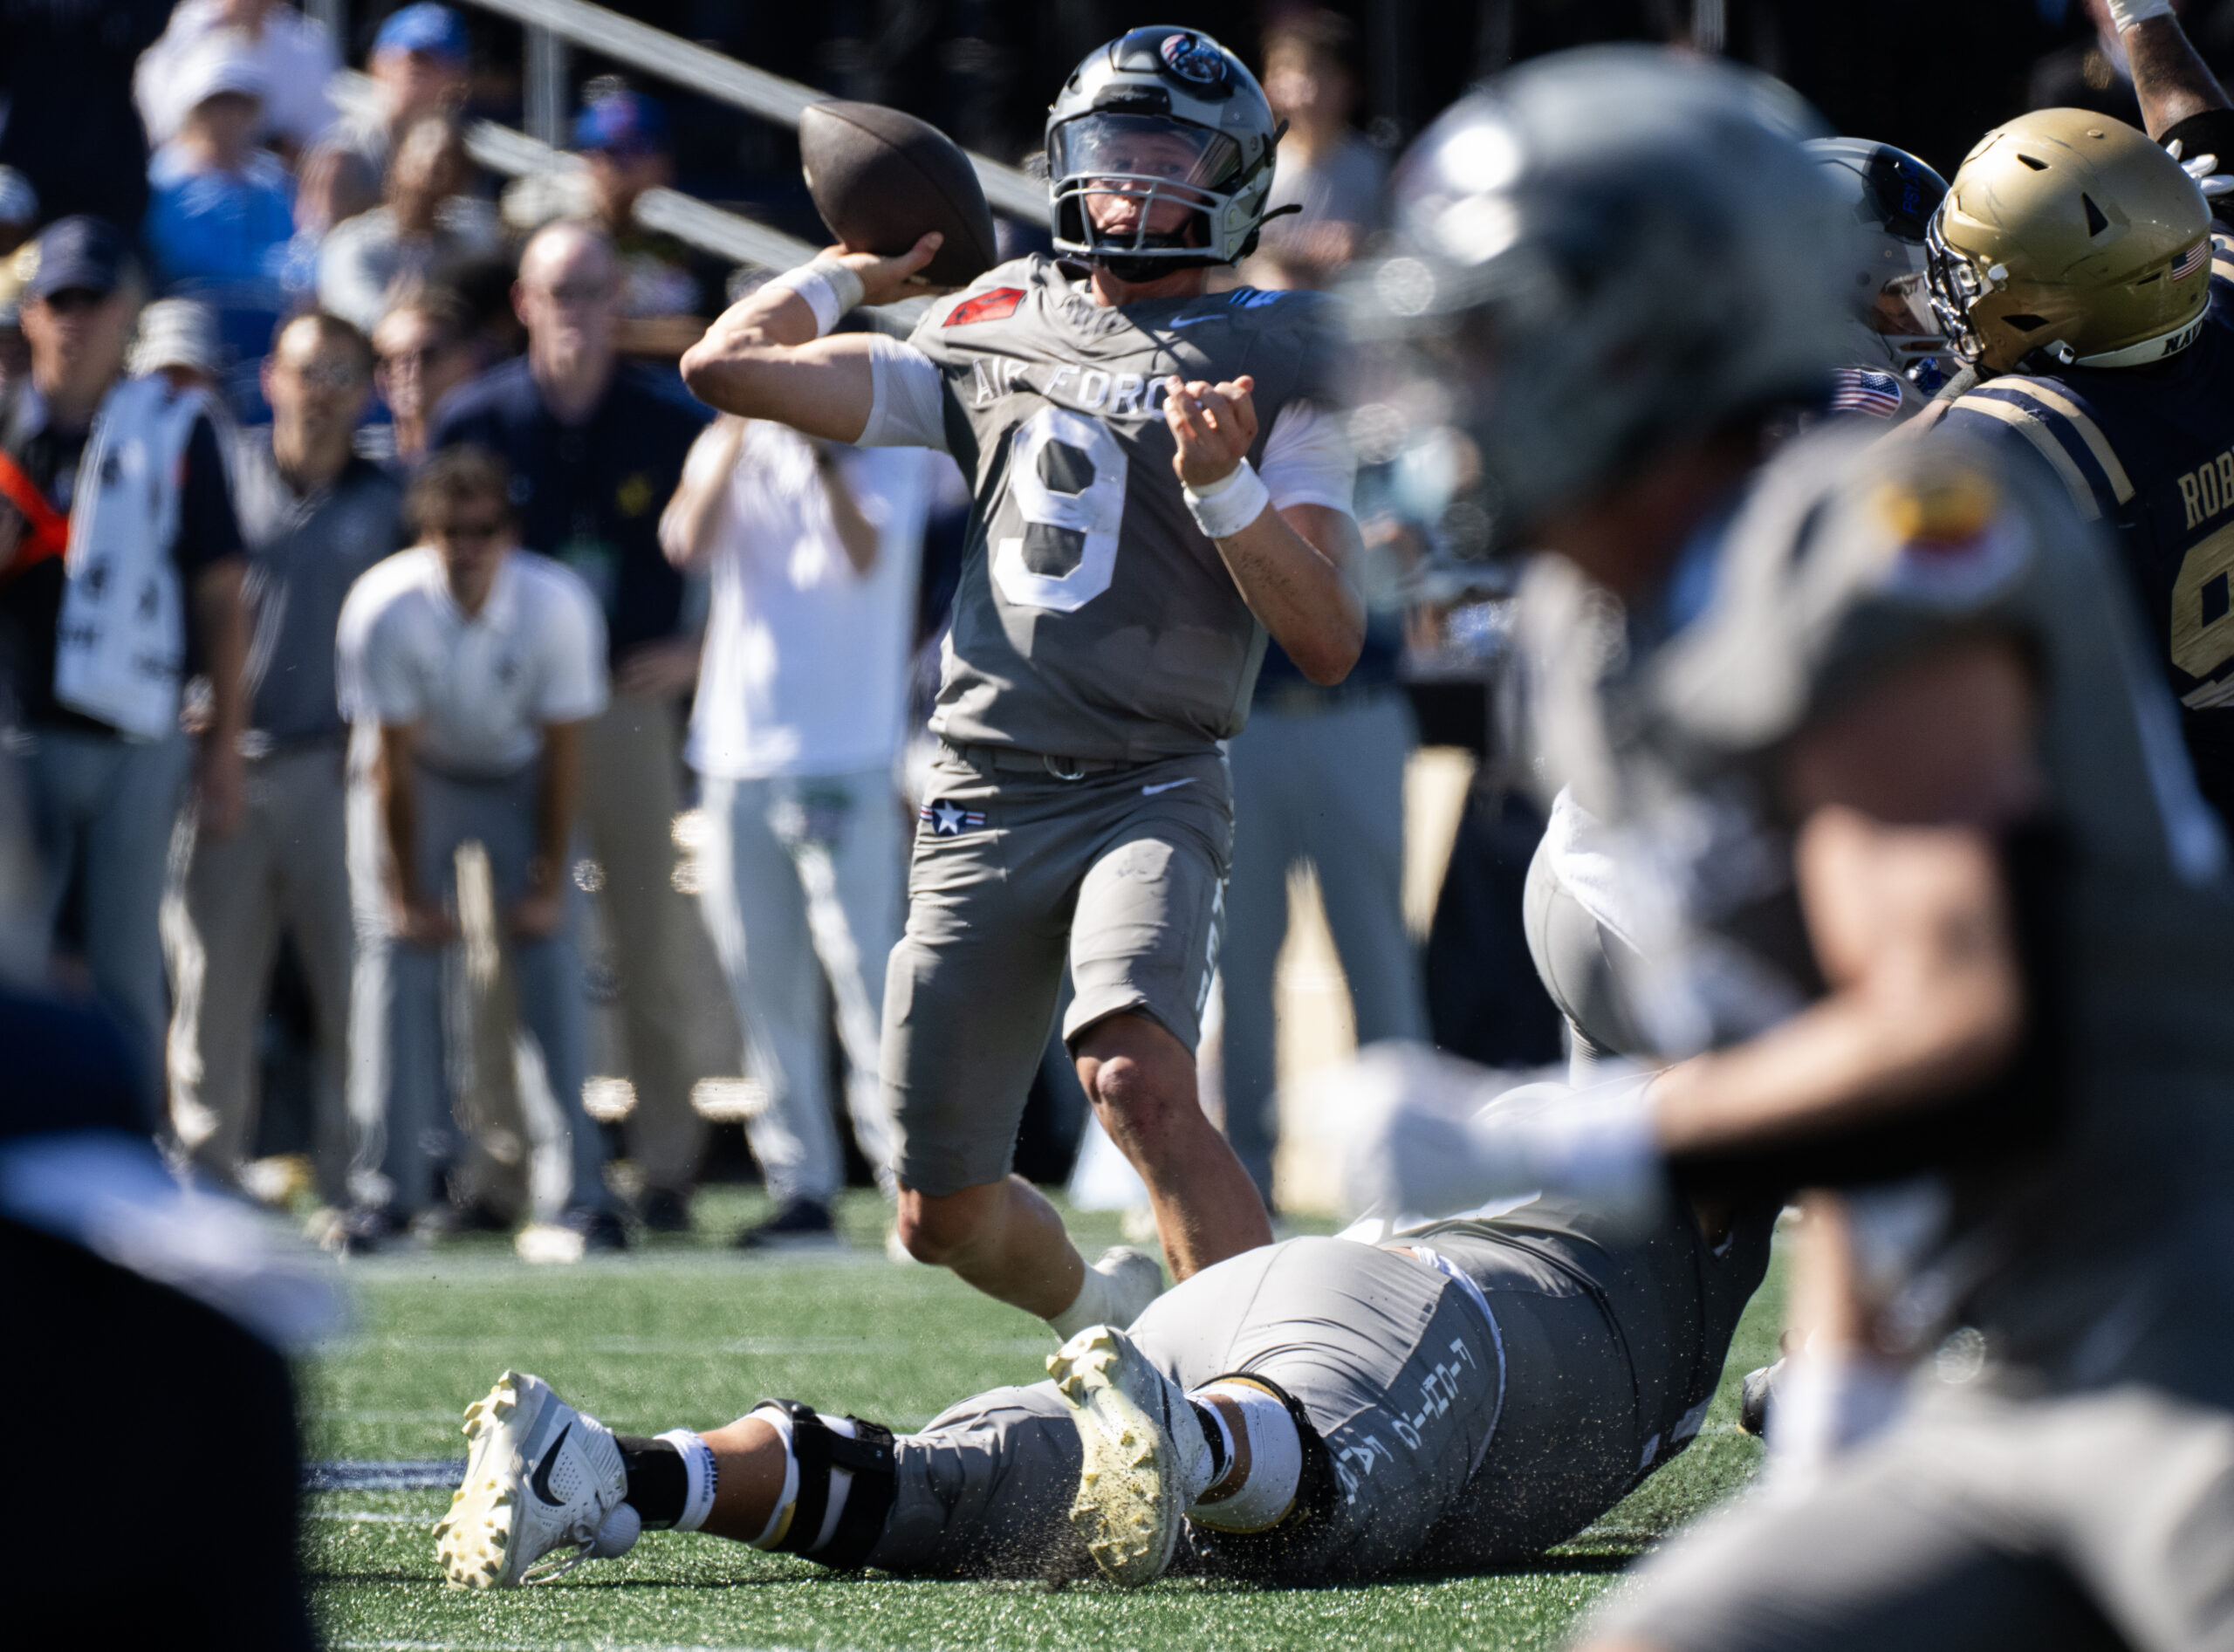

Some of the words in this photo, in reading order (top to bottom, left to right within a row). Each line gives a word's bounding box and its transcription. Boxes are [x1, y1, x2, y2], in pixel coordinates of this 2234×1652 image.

[2162, 321, 2202, 356] NAV
[972, 356, 1030, 405] AIR
[1042, 364, 1169, 421] FORC
[993, 404, 1129, 613] 9
[2176, 444, 2234, 531] ROB
